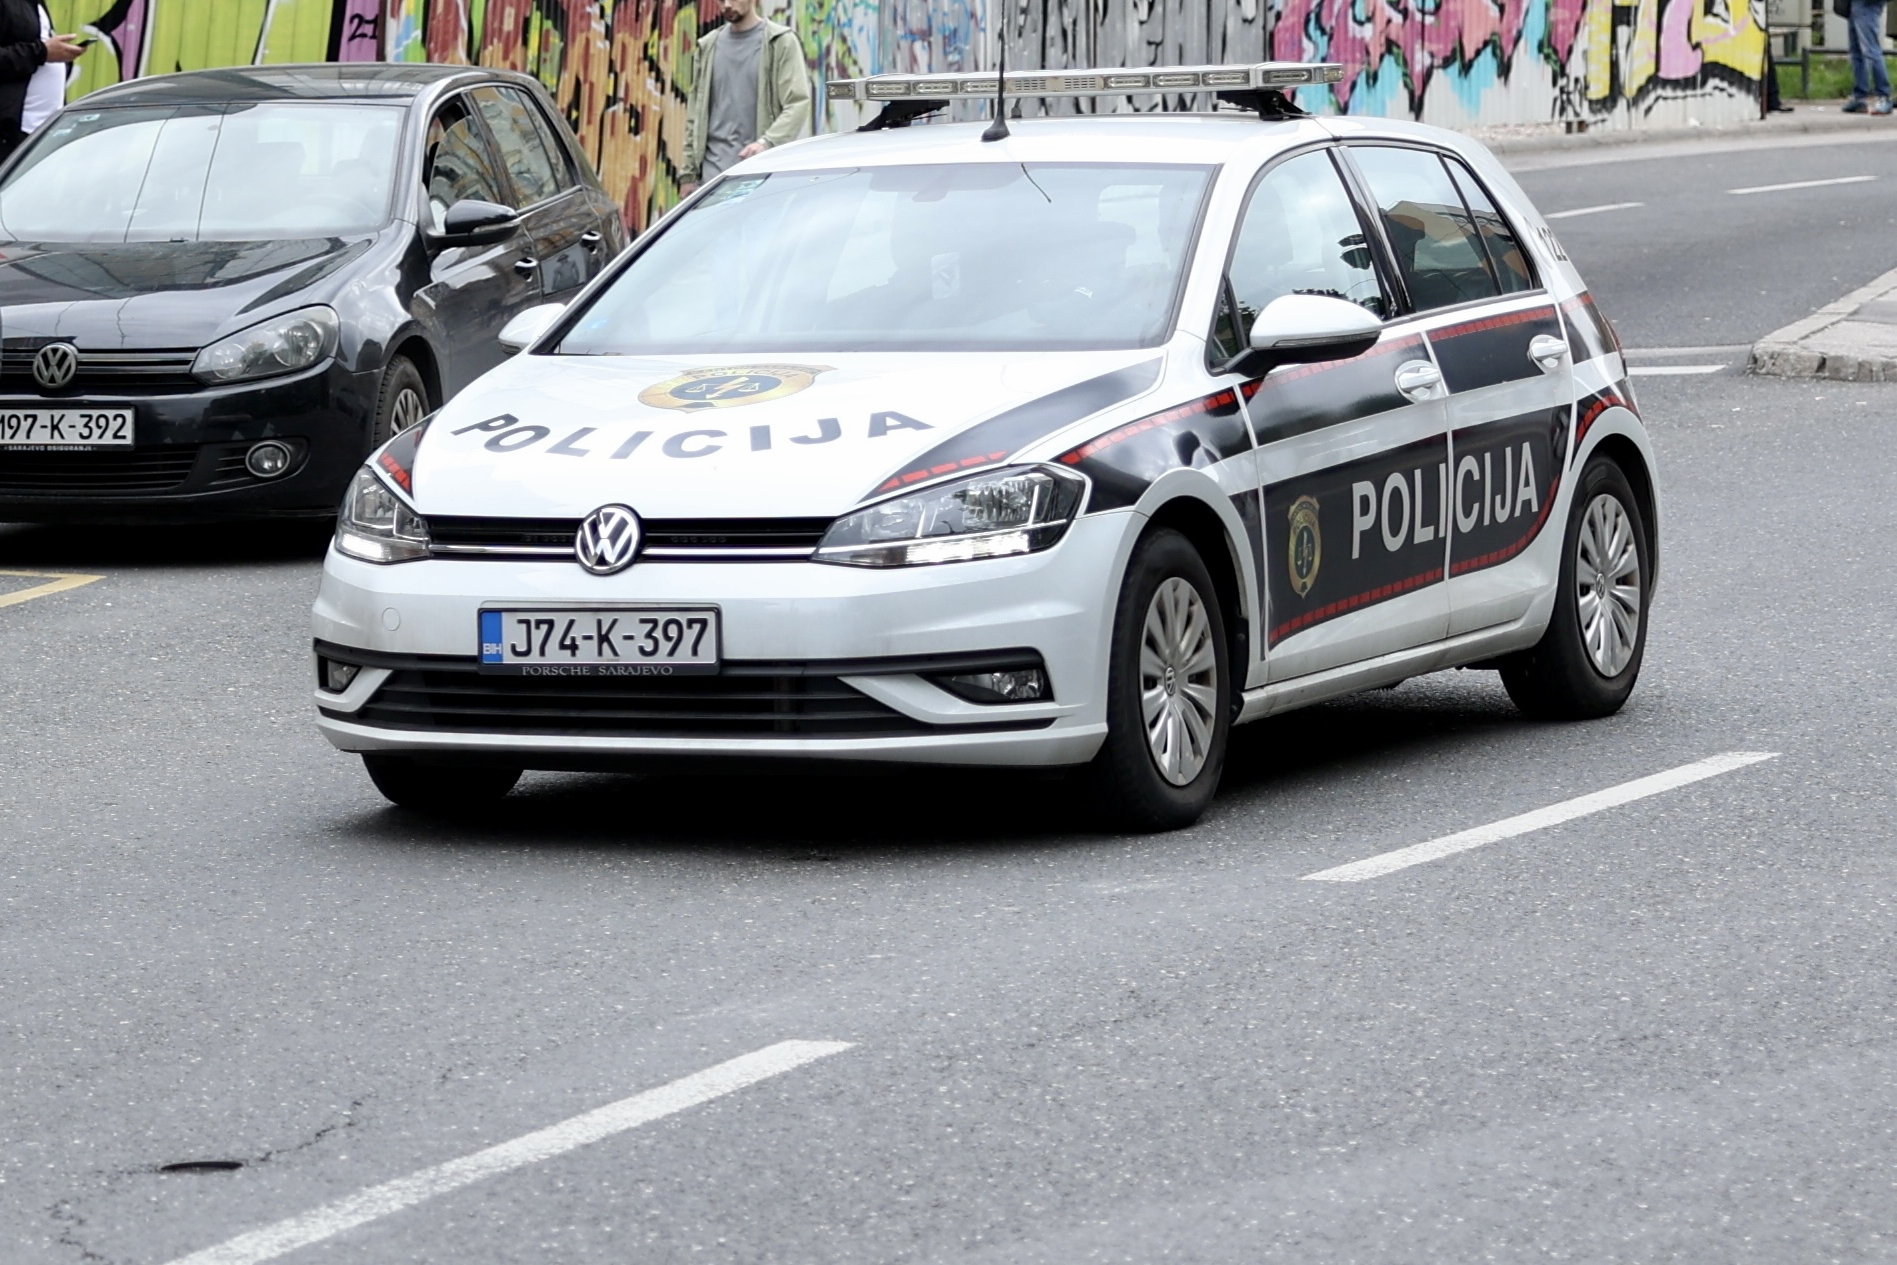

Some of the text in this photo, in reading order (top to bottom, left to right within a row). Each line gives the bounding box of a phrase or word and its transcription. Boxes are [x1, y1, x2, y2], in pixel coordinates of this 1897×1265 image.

[450, 410, 937, 460] POLICIJA
[1352, 441, 1539, 560] POLICIJA
[483, 643, 502, 655] BIH
[510, 617, 709, 658] J74-K-397
[522, 666, 674, 677] PORSCHE SARAJEVO
